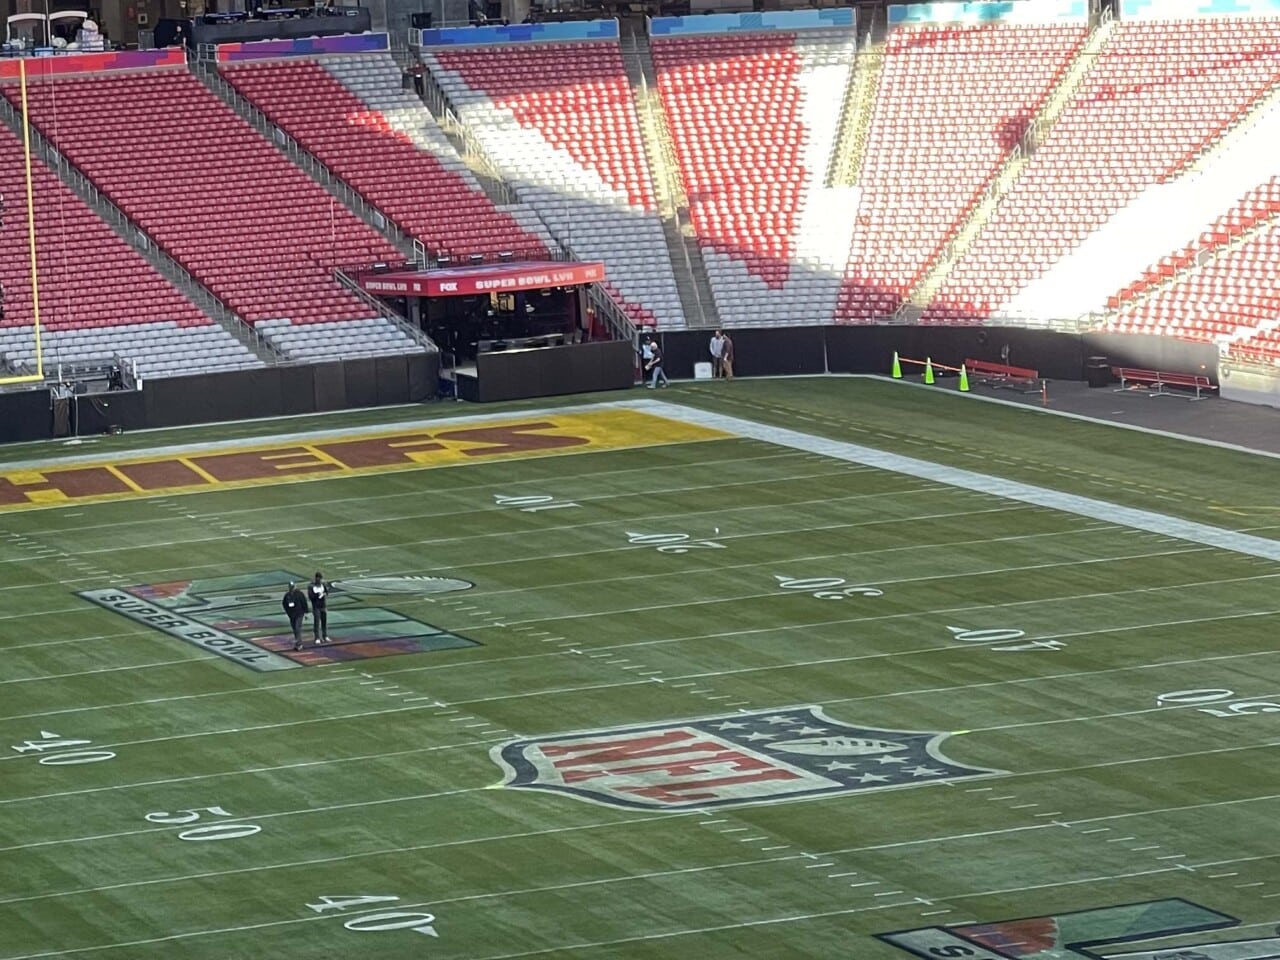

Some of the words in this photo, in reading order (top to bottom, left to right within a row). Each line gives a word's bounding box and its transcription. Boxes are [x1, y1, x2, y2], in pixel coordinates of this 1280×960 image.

[440, 282, 458, 292] FOX
[475, 278, 515, 290] SUPER
[517, 274, 551, 287] BOWL
[496, 495, 584, 513] 10
[628, 533, 727, 555] 20
[779, 576, 885, 601] 30
[99, 593, 190, 629] SUPER
[186, 630, 270, 663] BOWL
[954, 628, 1068, 652] 40
[1157, 689, 1280, 718] 50
[11, 738, 117, 765] 40
[539, 731, 805, 804] NFL
[145, 806, 262, 841] 50
[306, 894, 437, 932] 40
